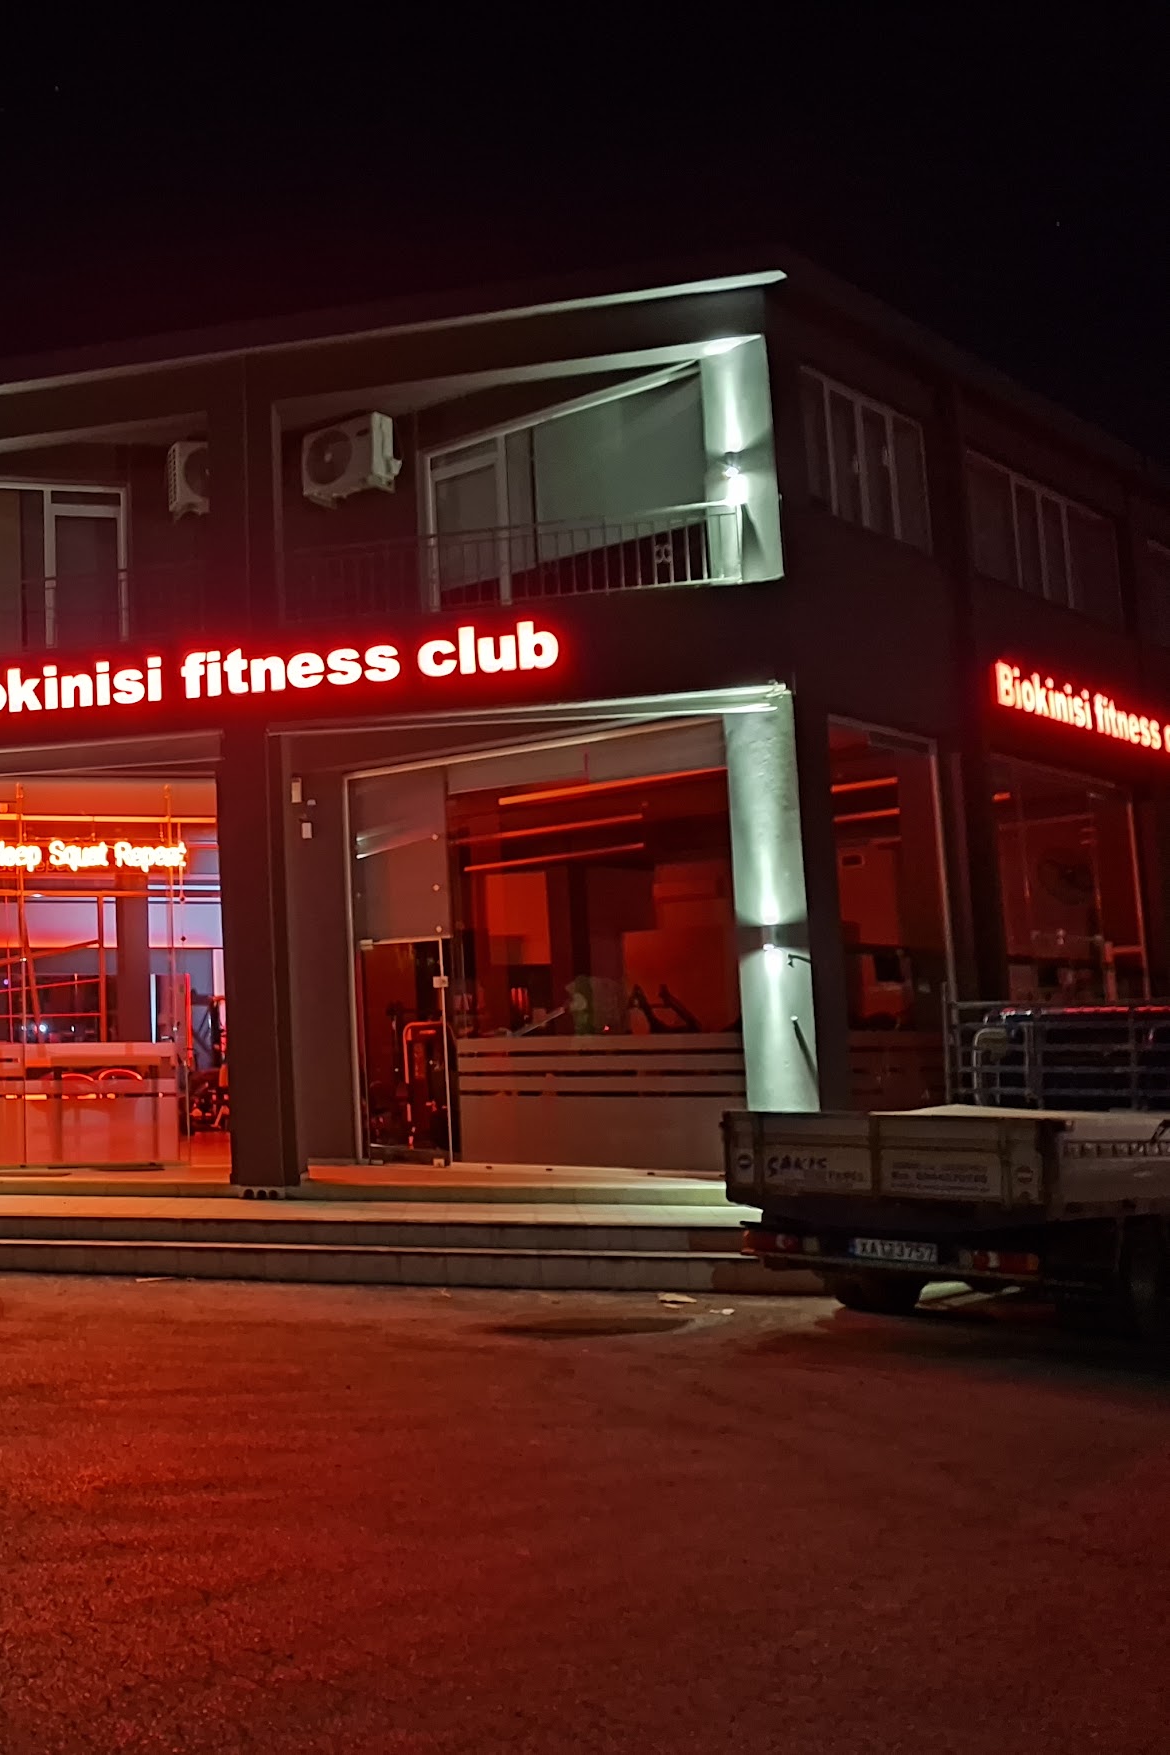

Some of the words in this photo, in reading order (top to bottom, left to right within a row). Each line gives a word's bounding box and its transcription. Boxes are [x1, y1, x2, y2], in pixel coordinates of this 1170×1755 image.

[180, 646, 401, 699] fitness
[417, 621, 559, 677] club
[995, 660, 1093, 730] Biokinisi
[1093, 693, 1162, 750] fitness
[48, 840, 109, 872] Squat
[113, 840, 187, 873] Repeat
